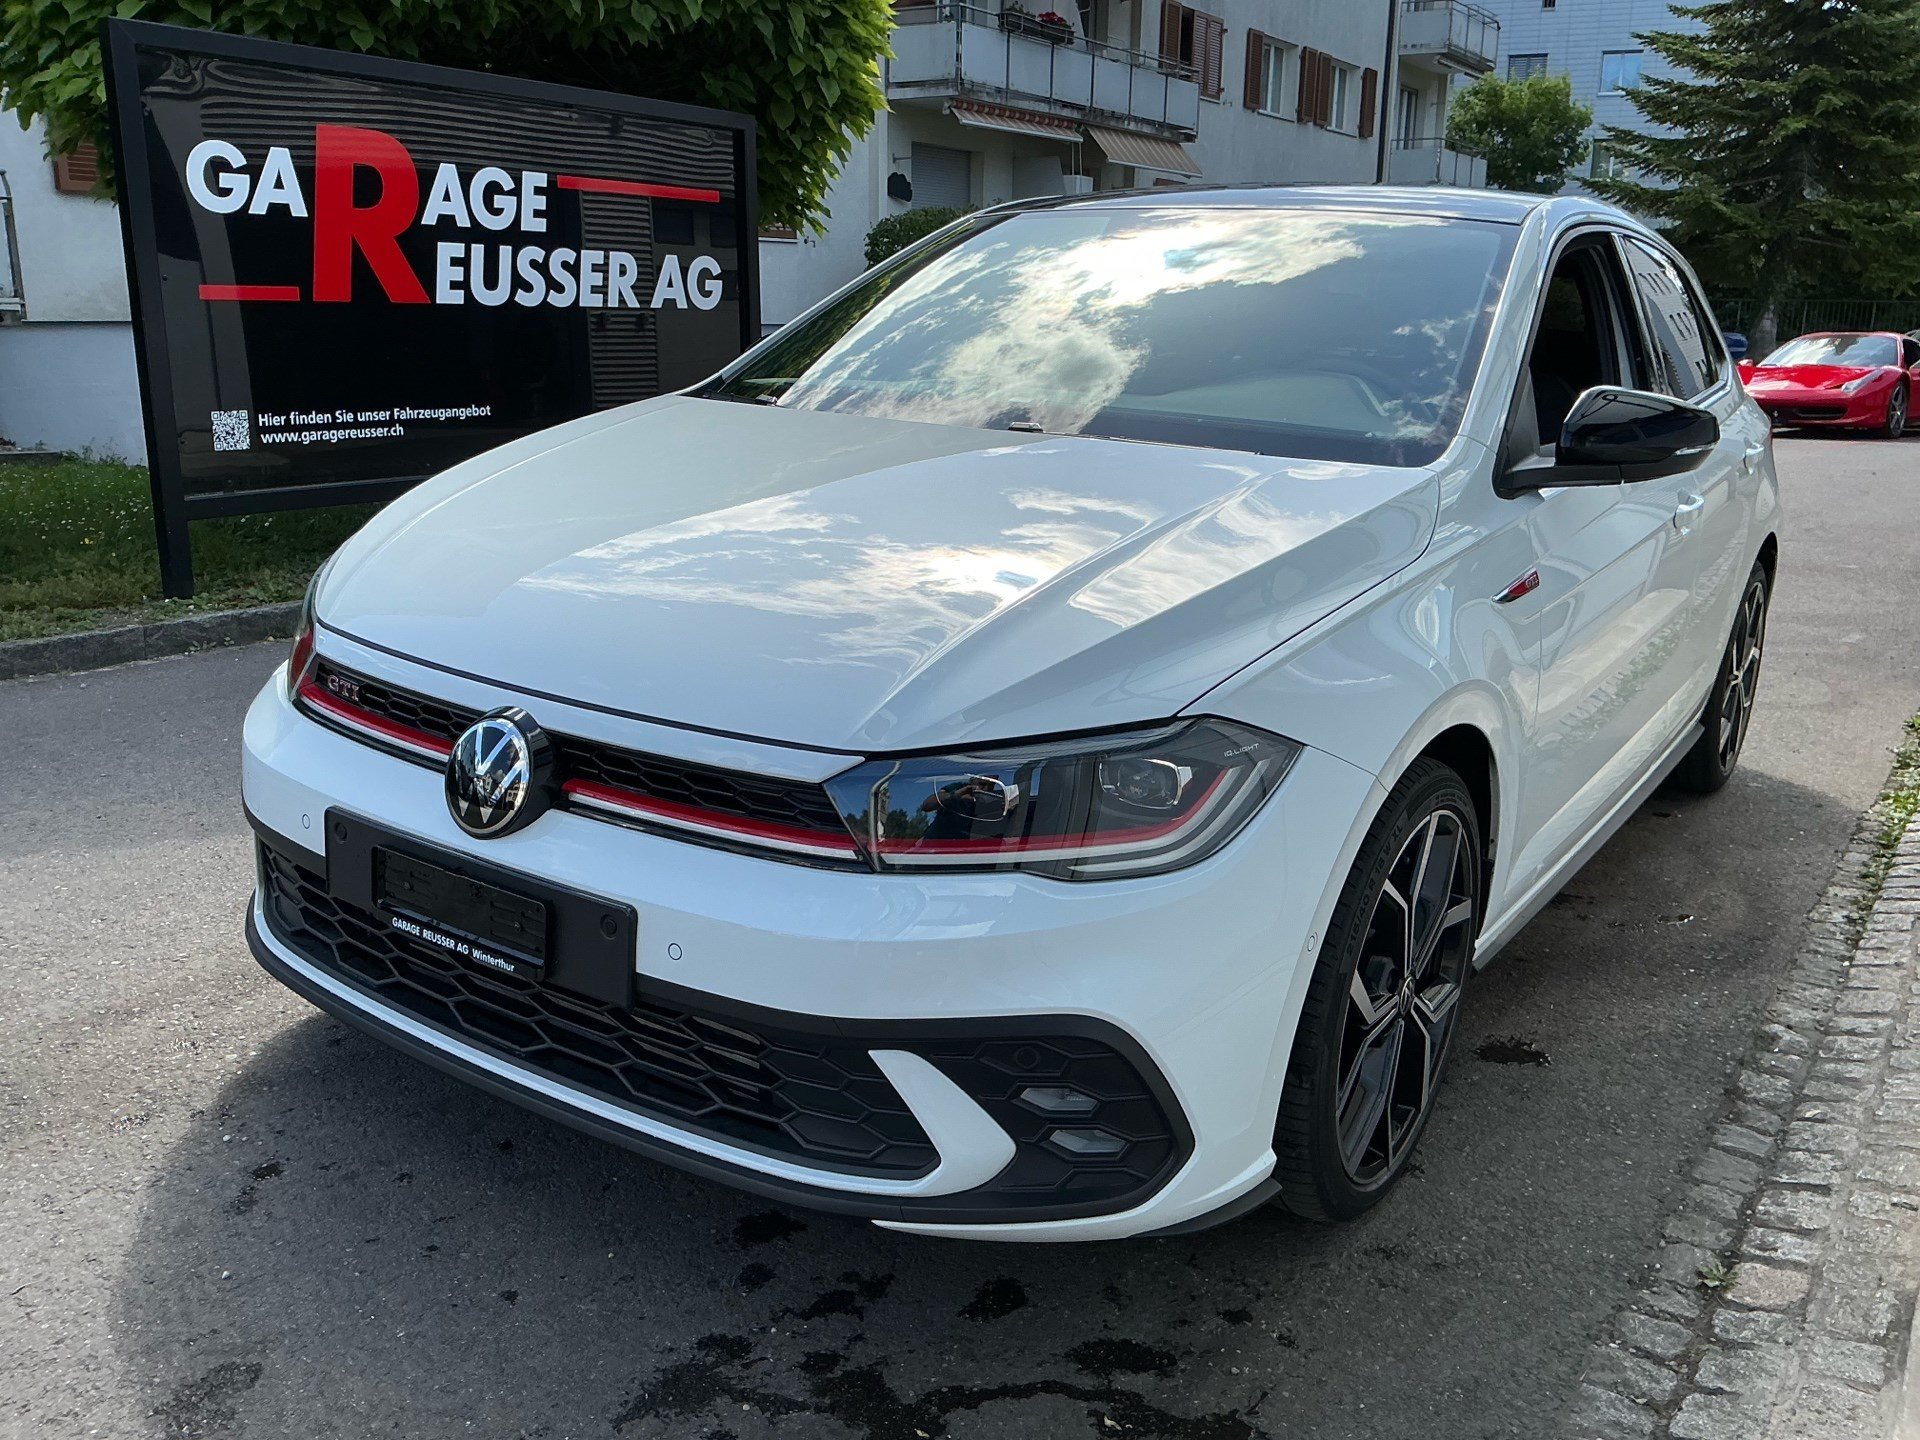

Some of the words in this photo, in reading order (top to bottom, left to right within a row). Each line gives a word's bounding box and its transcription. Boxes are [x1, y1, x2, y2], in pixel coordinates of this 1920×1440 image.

[186, 124, 548, 303] GARAGE
[650, 254, 723, 310] AG
[258, 413, 287, 427] Hier
[289, 410, 332, 425] finden
[335, 410, 354, 423] Sie
[357, 410, 391, 421] unser
[393, 404, 491, 421] Fahrzeugangebot
[260, 423, 404, 445] www.garagereusser.ch
[327, 674, 360, 702] GTI
[392, 917, 421, 936] GARAGE
[422, 929, 455, 950] REUSSER
[456, 942, 469, 955] AG
[472, 948, 515, 972] Winterthur
